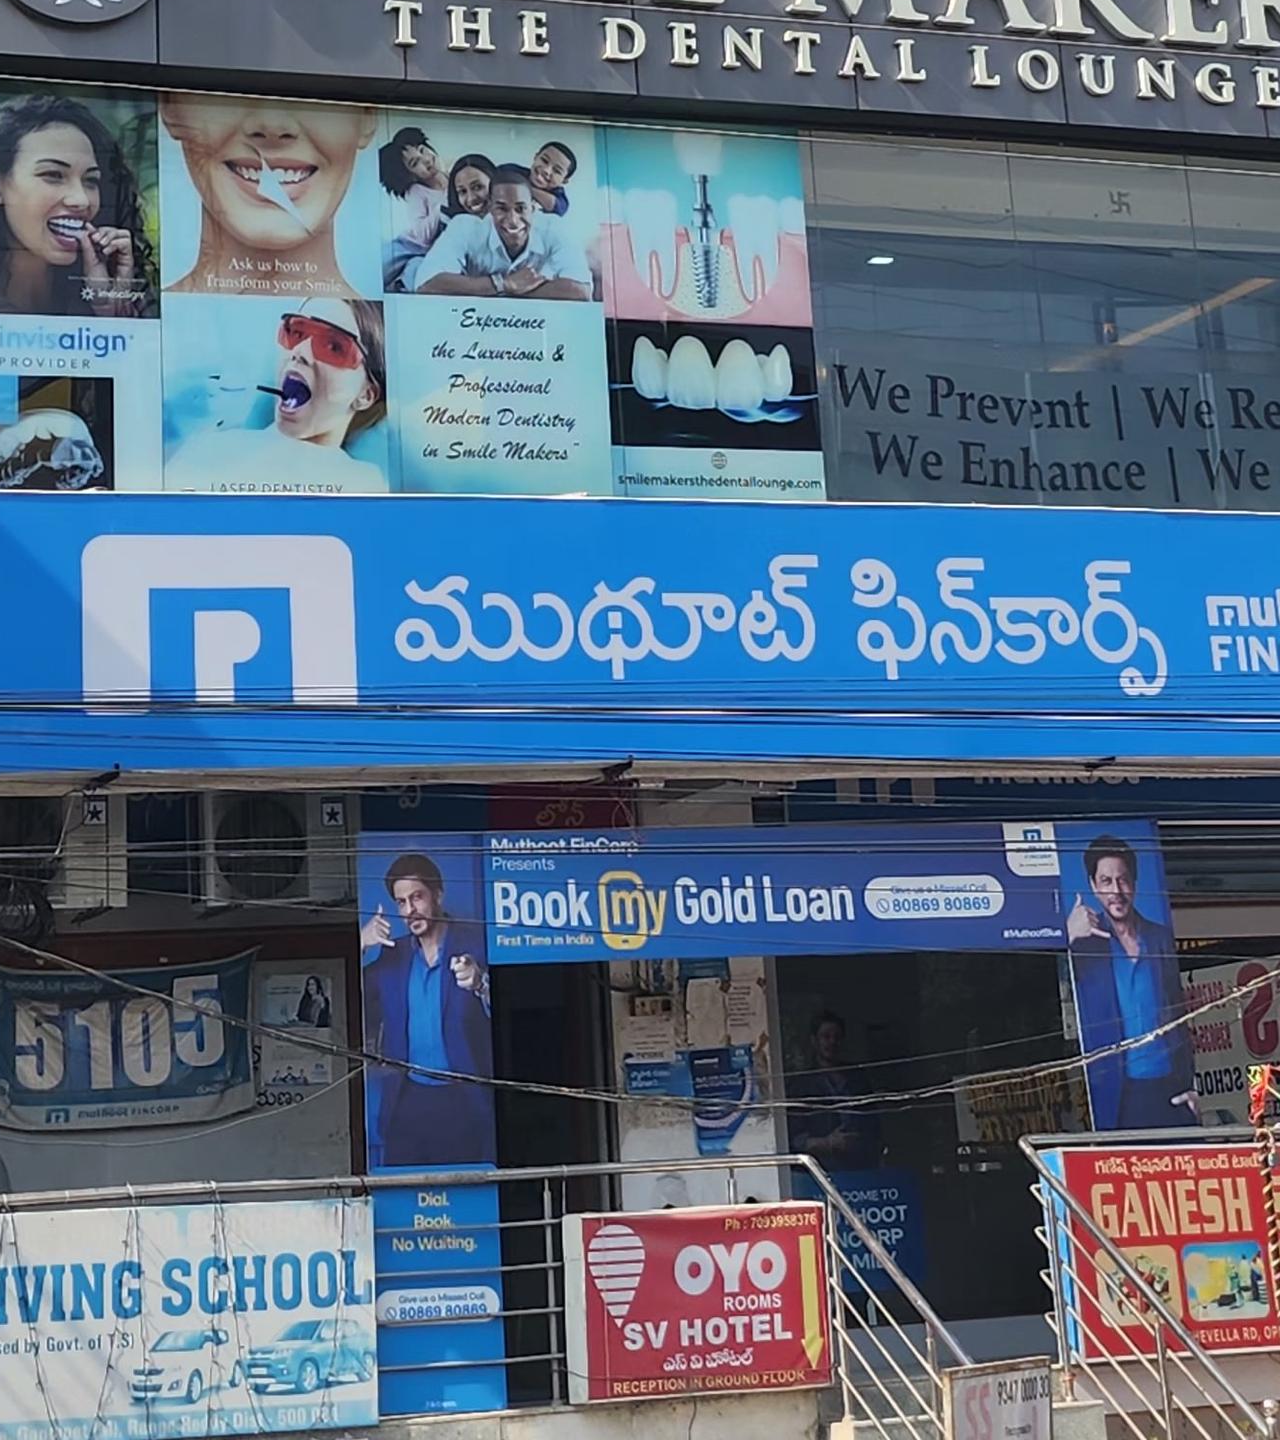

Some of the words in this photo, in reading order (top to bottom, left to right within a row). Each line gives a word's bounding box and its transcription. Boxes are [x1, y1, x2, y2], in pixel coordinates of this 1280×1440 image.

[601, 16, 927, 83] DENTAL
[228, 256, 254, 274] Ask
[273, 257, 302, 273] how
[304, 259, 319, 274] to
[206, 273, 270, 292] Transform
[273, 278, 302, 295] your
[304, 277, 342, 294] Smile
[431, 343, 456, 360] the
[460, 341, 546, 363] Luxurious
[551, 344, 566, 362] &
[448, 375, 552, 397] Professional
[833, 363, 912, 415] We
[926, 374, 1091, 430] Prevent
[1141, 385, 1216, 430] We
[423, 406, 492, 426] Modern
[496, 408, 577, 433] Dentistry
[423, 443, 440, 460] in
[445, 440, 501, 460] Smile
[865, 430, 943, 481] We
[959, 440, 1145, 492] Enhance
[1197, 448, 1270, 491] We
[618, 474, 822, 492] smilemakersthedentallounge.com
[491, 858, 556, 872] Presents
[493, 878, 593, 929] Book
[610, 886, 667, 937] my
[675, 875, 756, 925] Gold
[763, 875, 855, 923] Loan
[892, 898, 940, 913] 80869
[944, 896, 990, 912] 80869
[496, 934, 522, 947] First
[524, 934, 551, 947] Time
[565, 933, 594, 946] India
[15, 974, 225, 1091] 5105
[418, 1191, 450, 1208] Dial.
[1091, 1176, 1254, 1239] GANESH
[392, 1237, 415, 1252] No
[417, 1235, 478, 1253] Waiting.
[674, 1240, 787, 1296] OYO
[162, 1250, 373, 1317] SCHOOL
[724, 1294, 782, 1312] ROOMS
[624, 1320, 668, 1352] SV
[680, 1314, 793, 1347] HOTEL
[24, 1338, 39, 1358] by
[46, 1335, 82, 1354] Govt.
[87, 1334, 104, 1352] of
[613, 1376, 687, 1395] RECEPTION
[705, 1373, 759, 1389] GROUND
[763, 1370, 807, 1383] FLOOR
